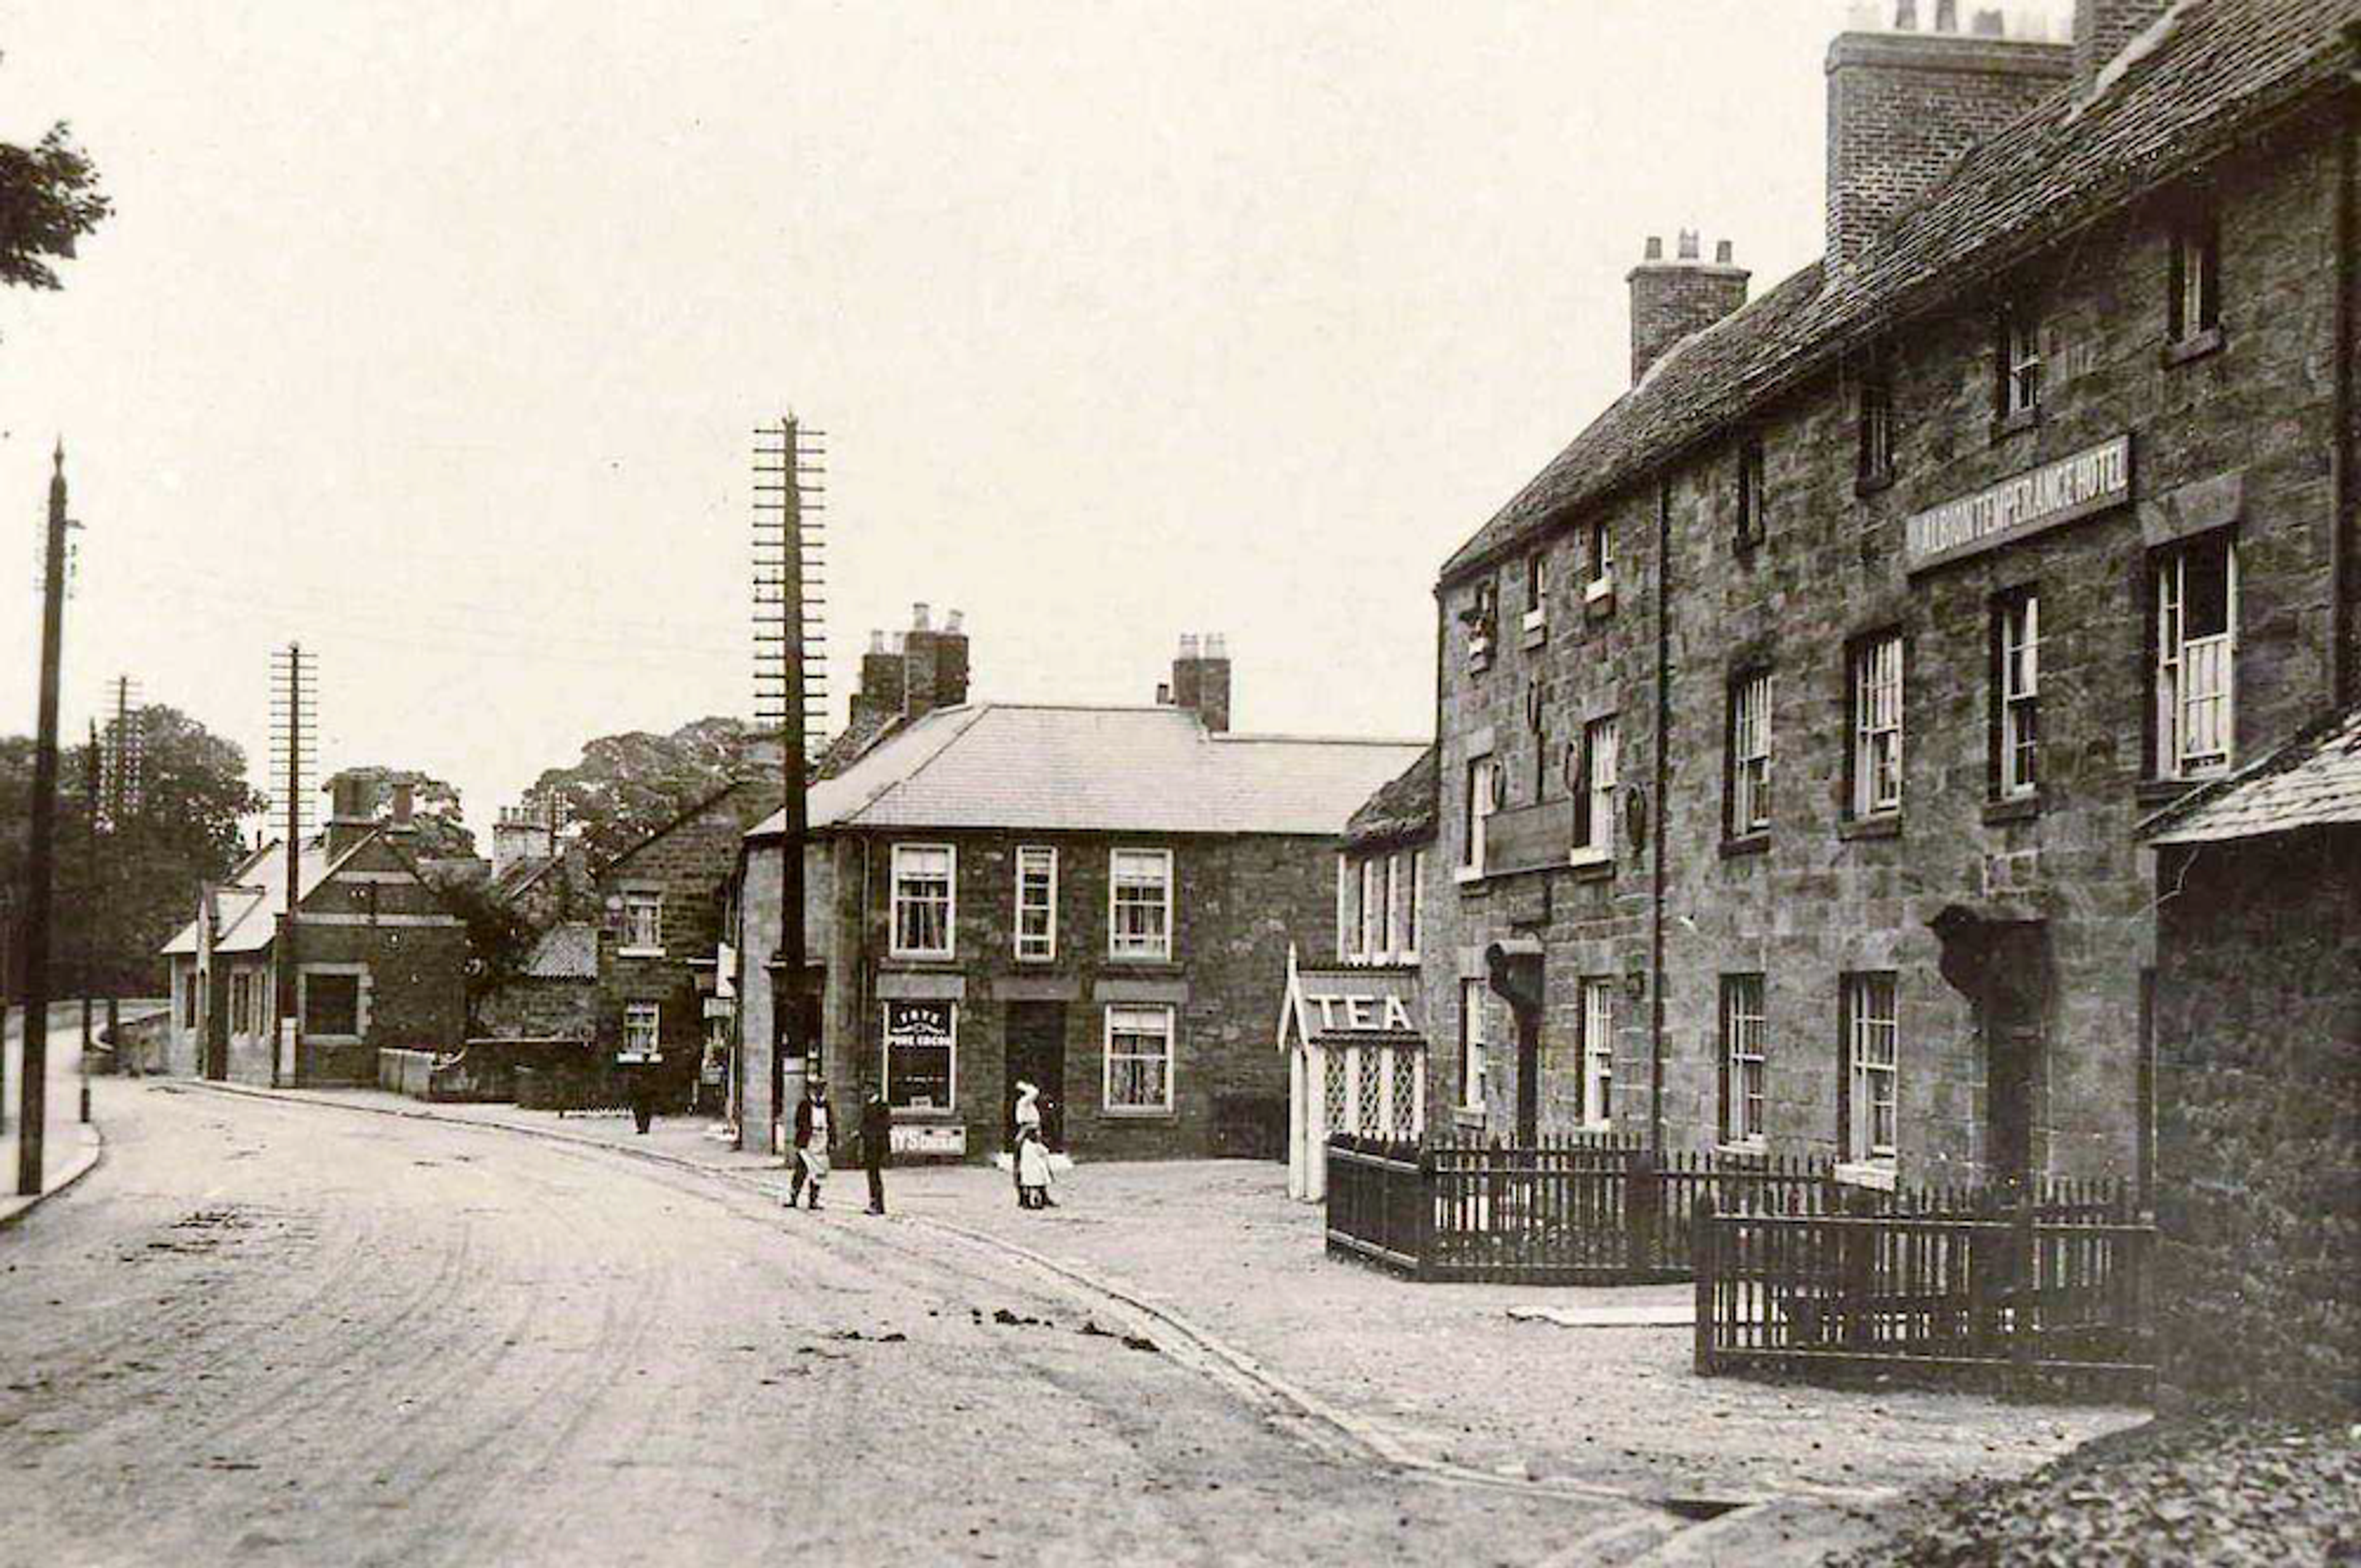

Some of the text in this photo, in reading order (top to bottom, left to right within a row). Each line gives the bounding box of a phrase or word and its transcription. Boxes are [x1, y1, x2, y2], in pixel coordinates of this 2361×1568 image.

[1974, 462, 2074, 539] TEMPERANCE
[2076, 443, 2128, 504] HOTEL
[1307, 993, 1413, 1031] TEA
